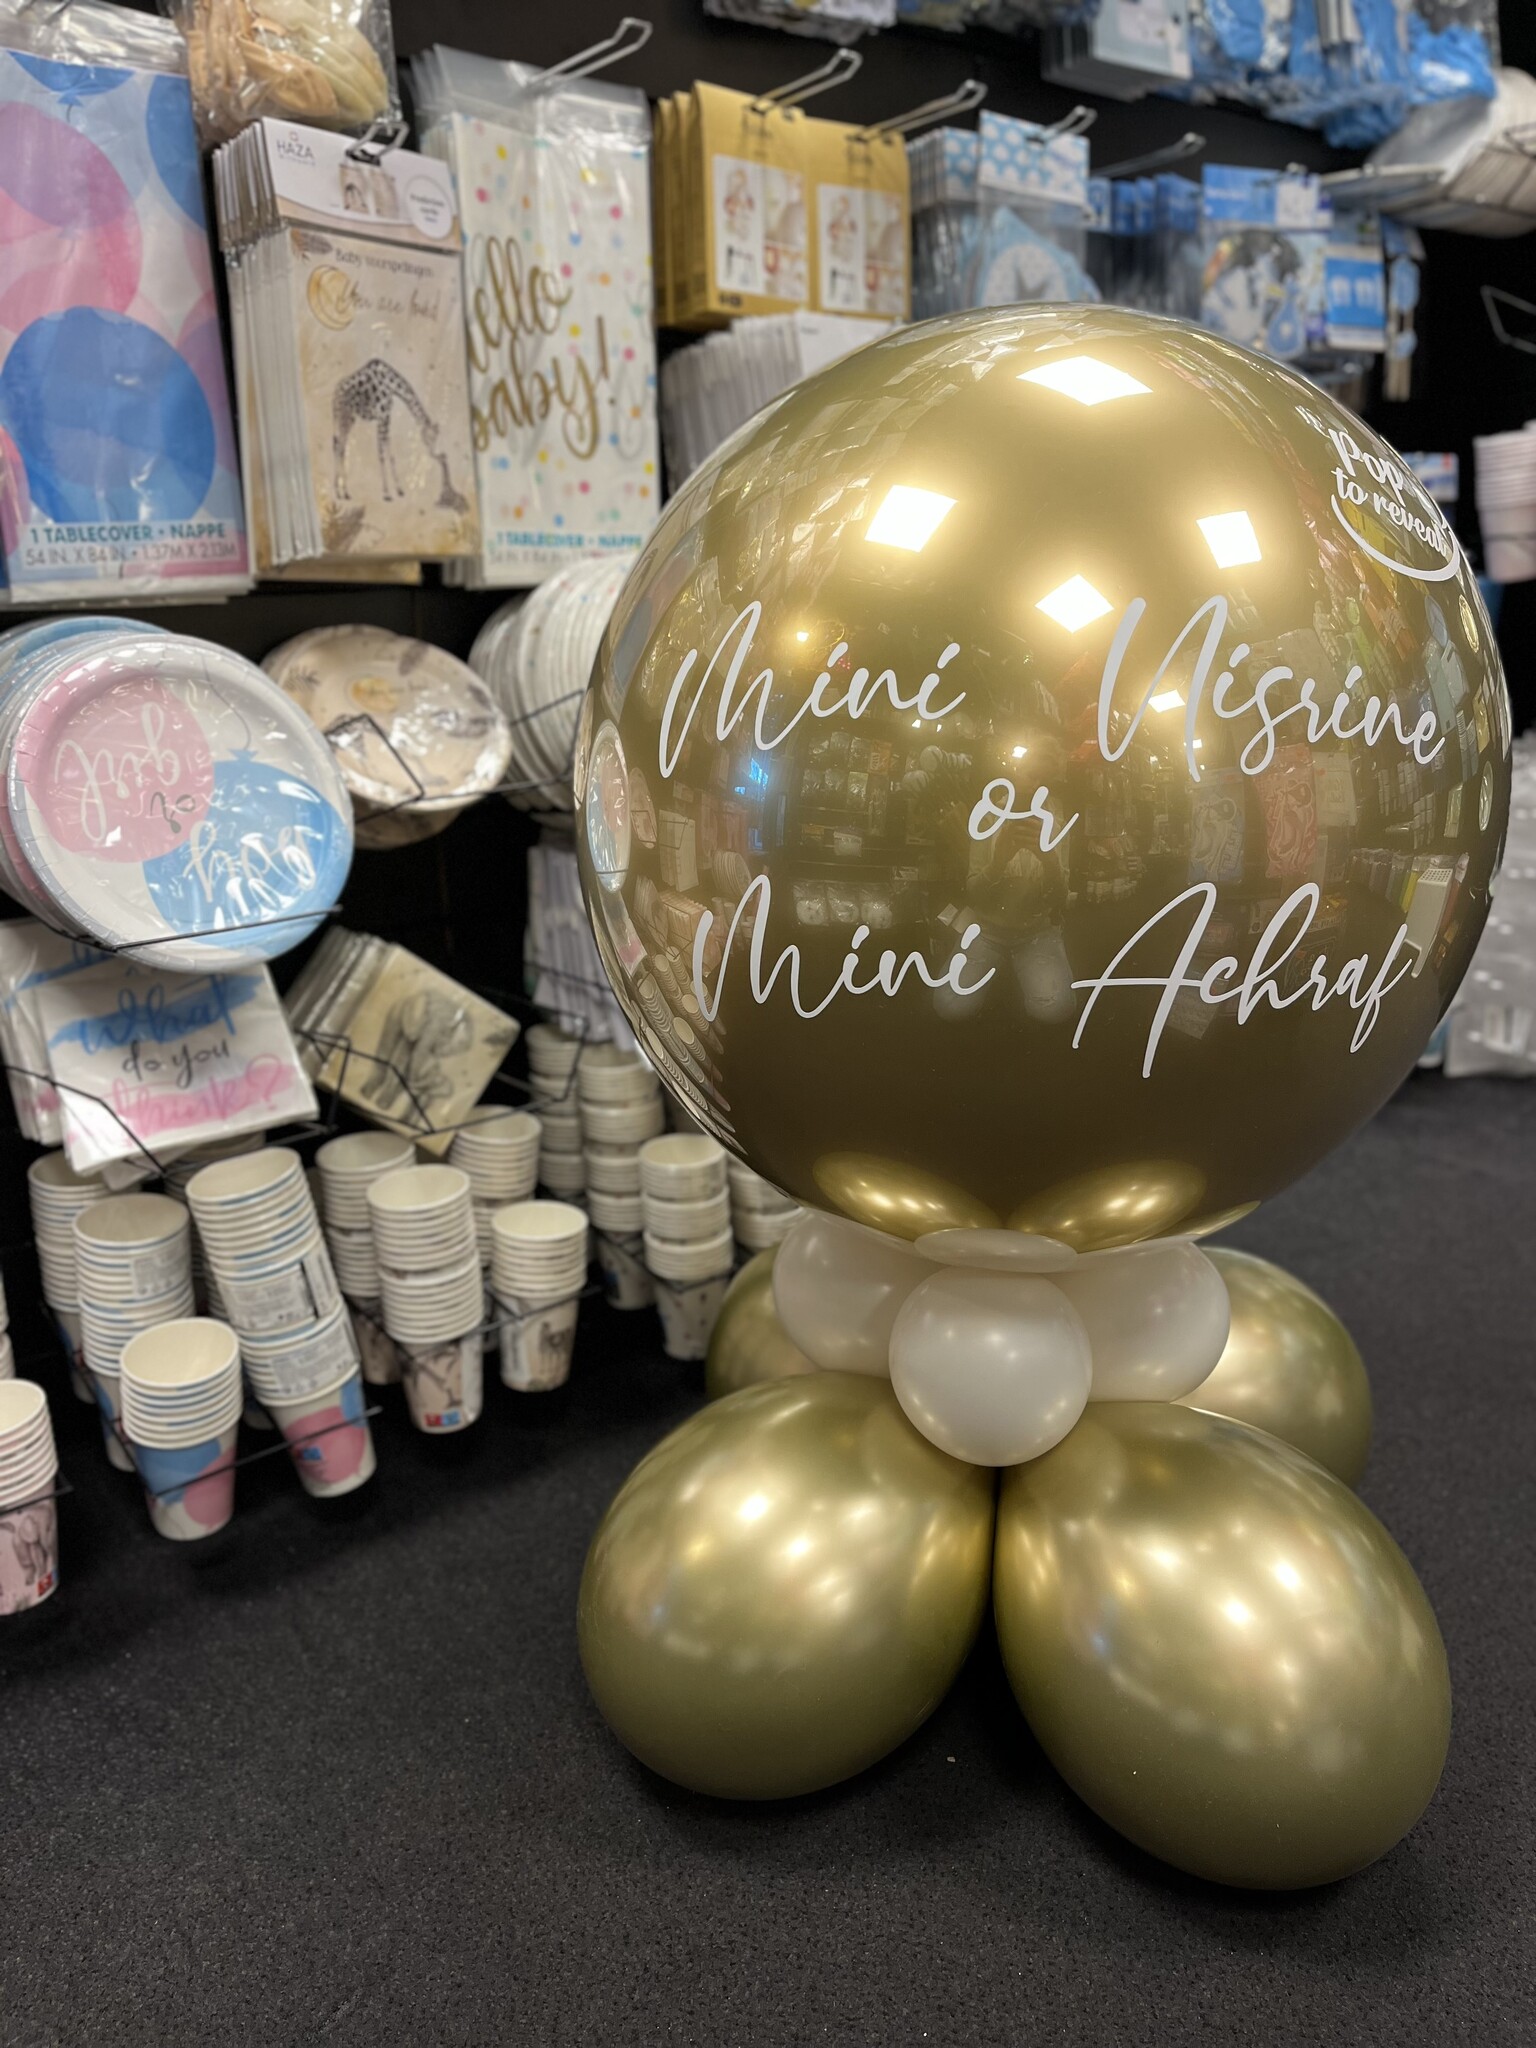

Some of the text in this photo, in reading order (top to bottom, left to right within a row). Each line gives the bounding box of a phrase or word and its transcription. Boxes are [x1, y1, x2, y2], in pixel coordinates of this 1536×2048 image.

[276, 139, 315, 160] HAZA
[466, 233, 574, 375] ello
[1328, 428, 1406, 508] Pop
[30, 522, 227, 544] 1 TABLECOVER NAPPE
[1331, 467, 1448, 558] to reveal
[26, 549, 46, 566] 54
[74, 547, 87, 563] X
[658, 594, 1447, 781] Mini Nisrine
[967, 778, 1079, 852] or
[80, 972, 237, 1055] What
[692, 873, 1413, 1079] Mini Achraf
[122, 1038, 231, 1090] do you
